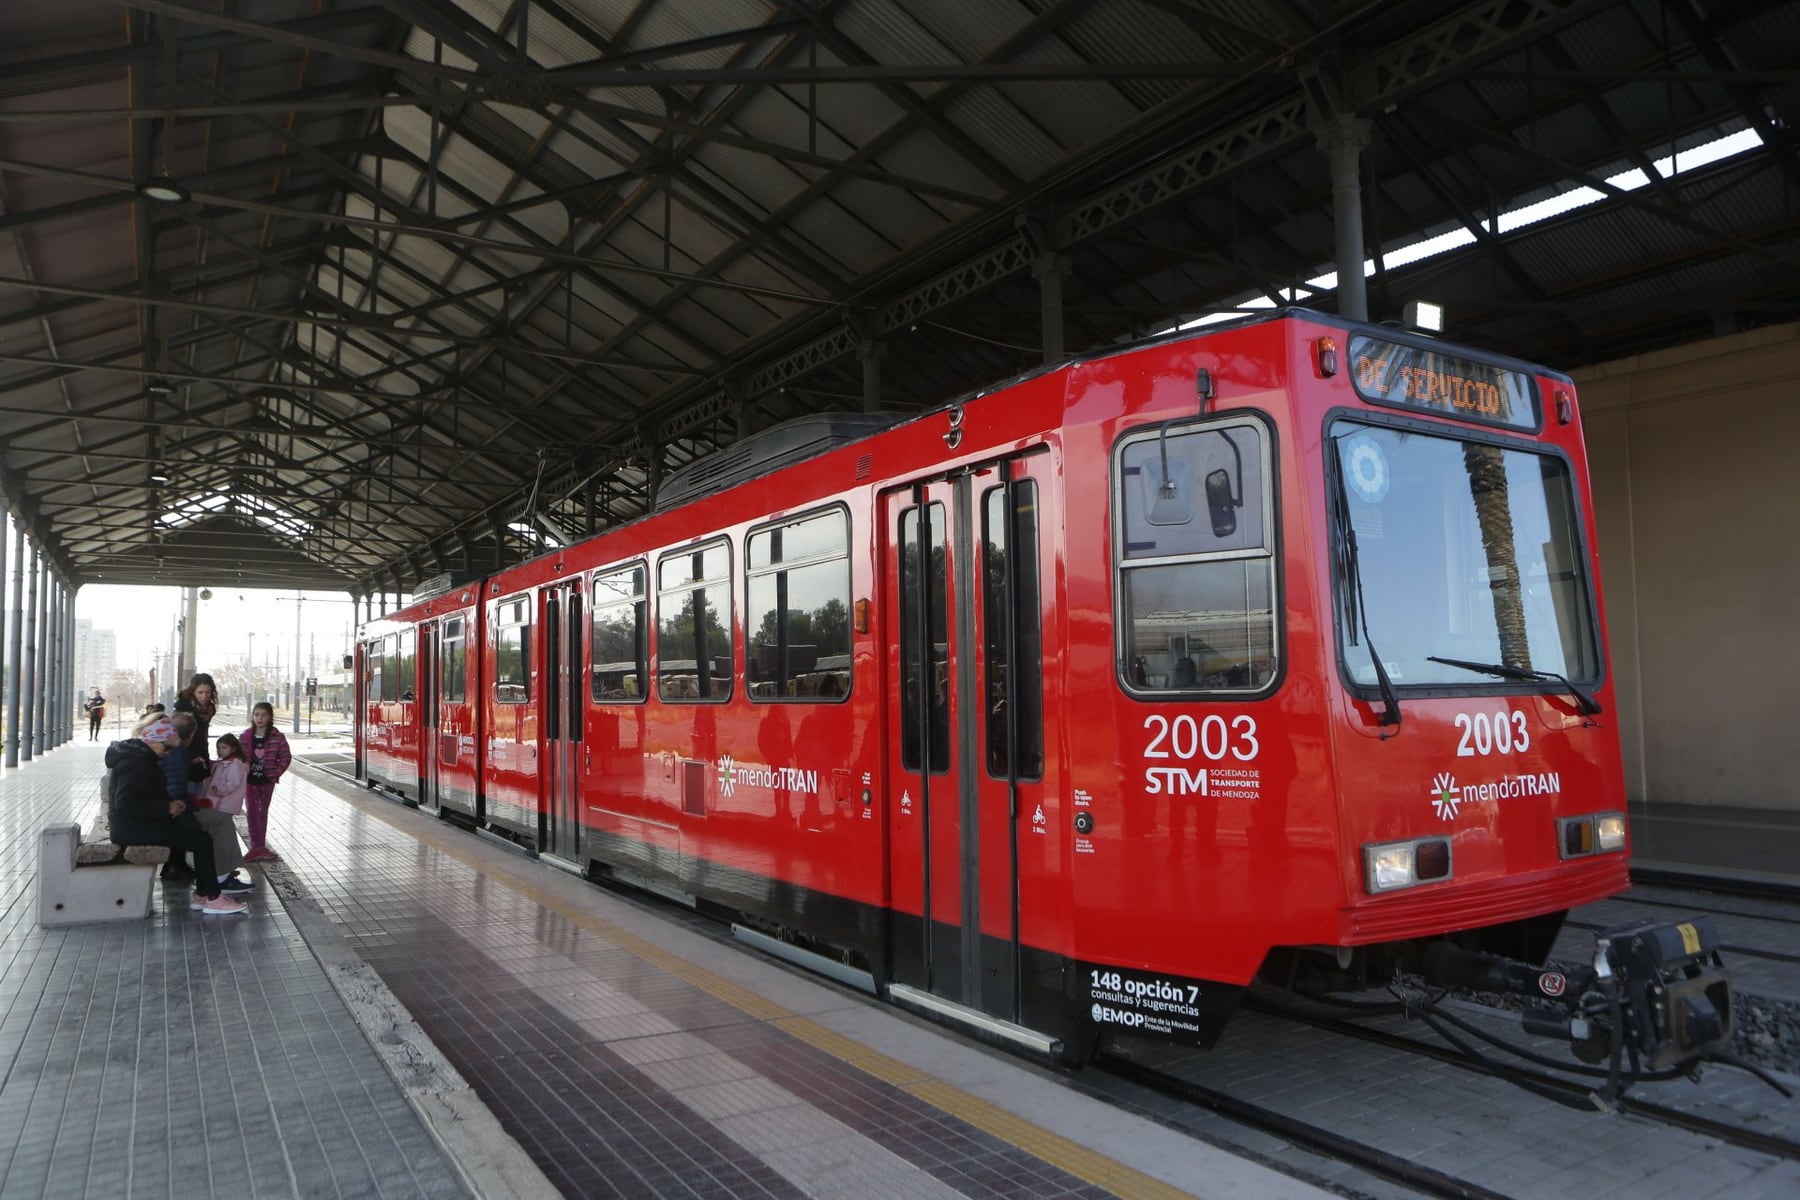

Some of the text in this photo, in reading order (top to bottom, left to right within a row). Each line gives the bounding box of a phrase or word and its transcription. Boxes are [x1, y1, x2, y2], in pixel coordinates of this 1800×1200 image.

[1359, 355, 1499, 415] DE SERVICIO
[1143, 714, 1260, 761] 2003
[1455, 710, 1530, 757] 2003
[738, 764, 818, 794] mendoTRAN
[1145, 767, 1208, 796] STM
[1210, 769, 1260, 778] SOCIEDAD DE
[1210, 779, 1260, 788] TRANSPORTE
[1463, 772, 1560, 802] mendoTRAN
[1222, 790, 1260, 799] MENDOZA
[1091, 970, 1199, 1004] 148 opción 7
[1091, 990, 1199, 1017] consultas y sugerencias
[1103, 1006, 1144, 1028] EMOP
[1144, 1022, 1171, 1033] Provincial
[1171, 1020, 1199, 1032] Movilidad
